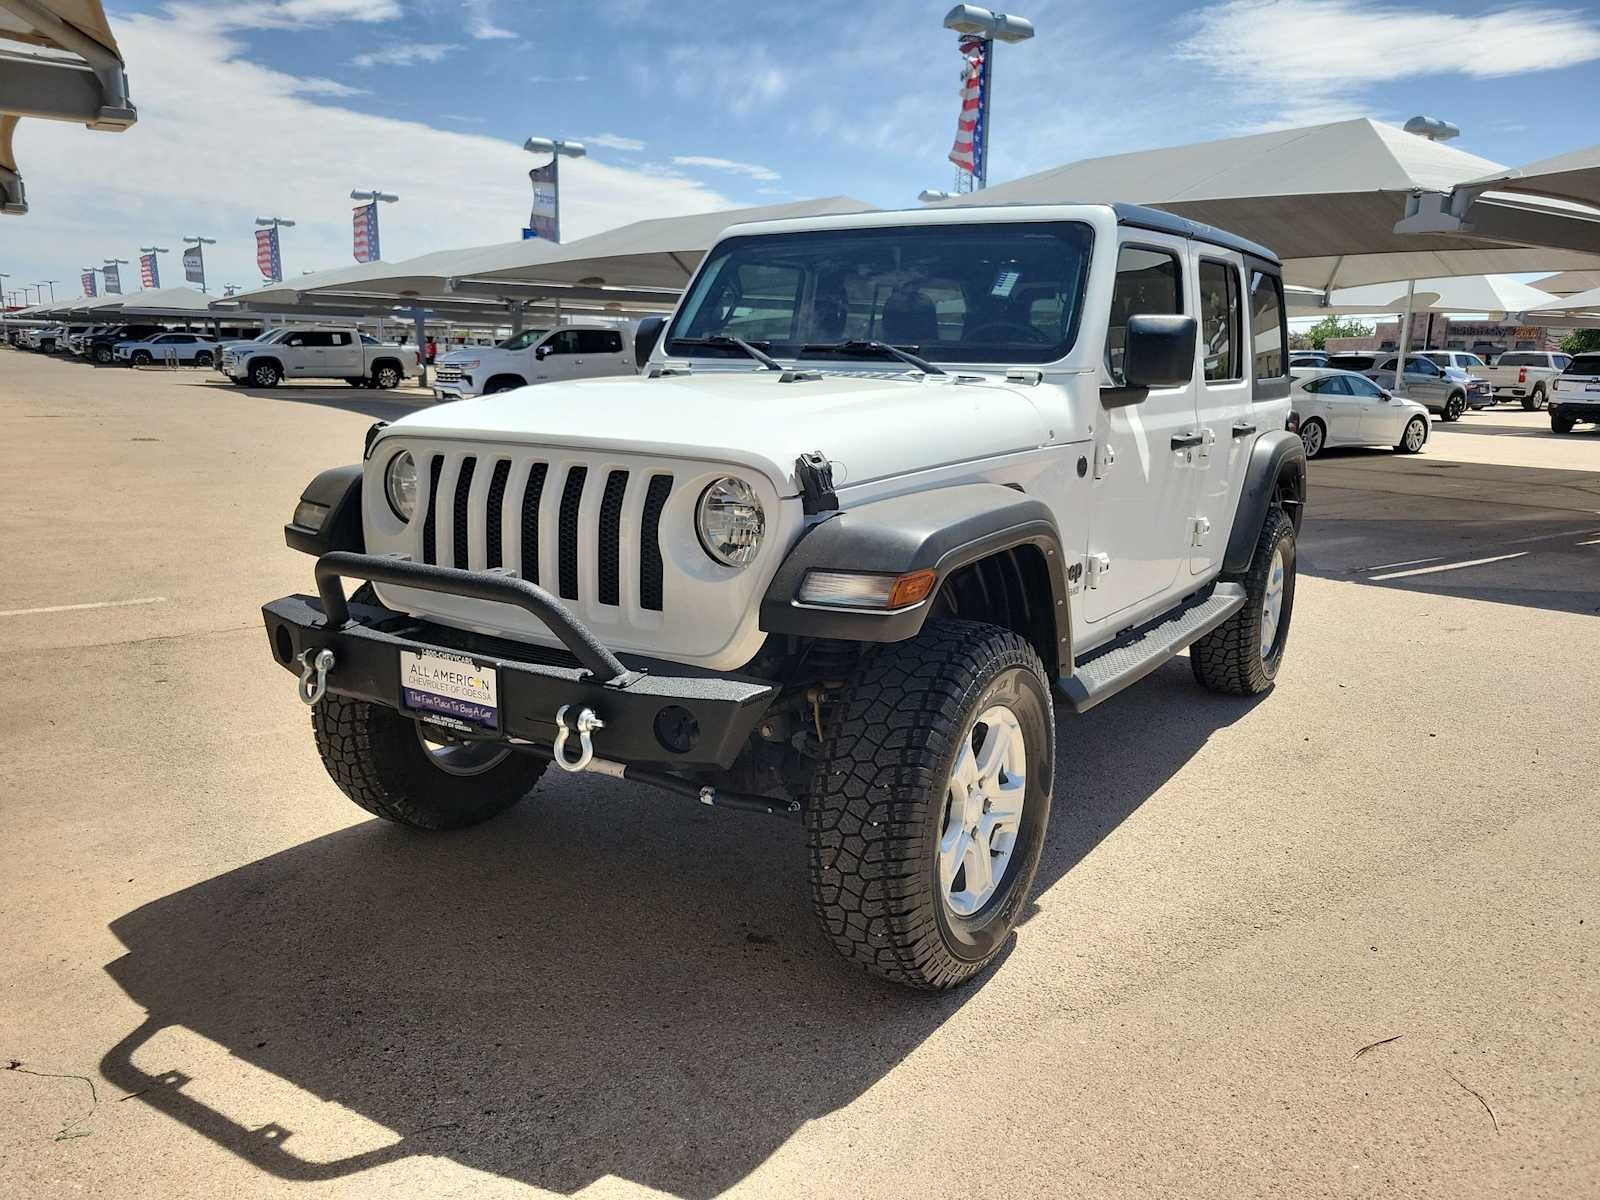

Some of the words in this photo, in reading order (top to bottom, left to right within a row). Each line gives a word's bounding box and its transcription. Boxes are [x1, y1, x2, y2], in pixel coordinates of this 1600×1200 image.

[409, 675, 449, 692] CHEVROLET
[450, 686, 460, 695] OF
[462, 687, 491, 701] ODESSA
[410, 664, 430, 678] ALL
[433, 669, 489, 690] AMERICN
